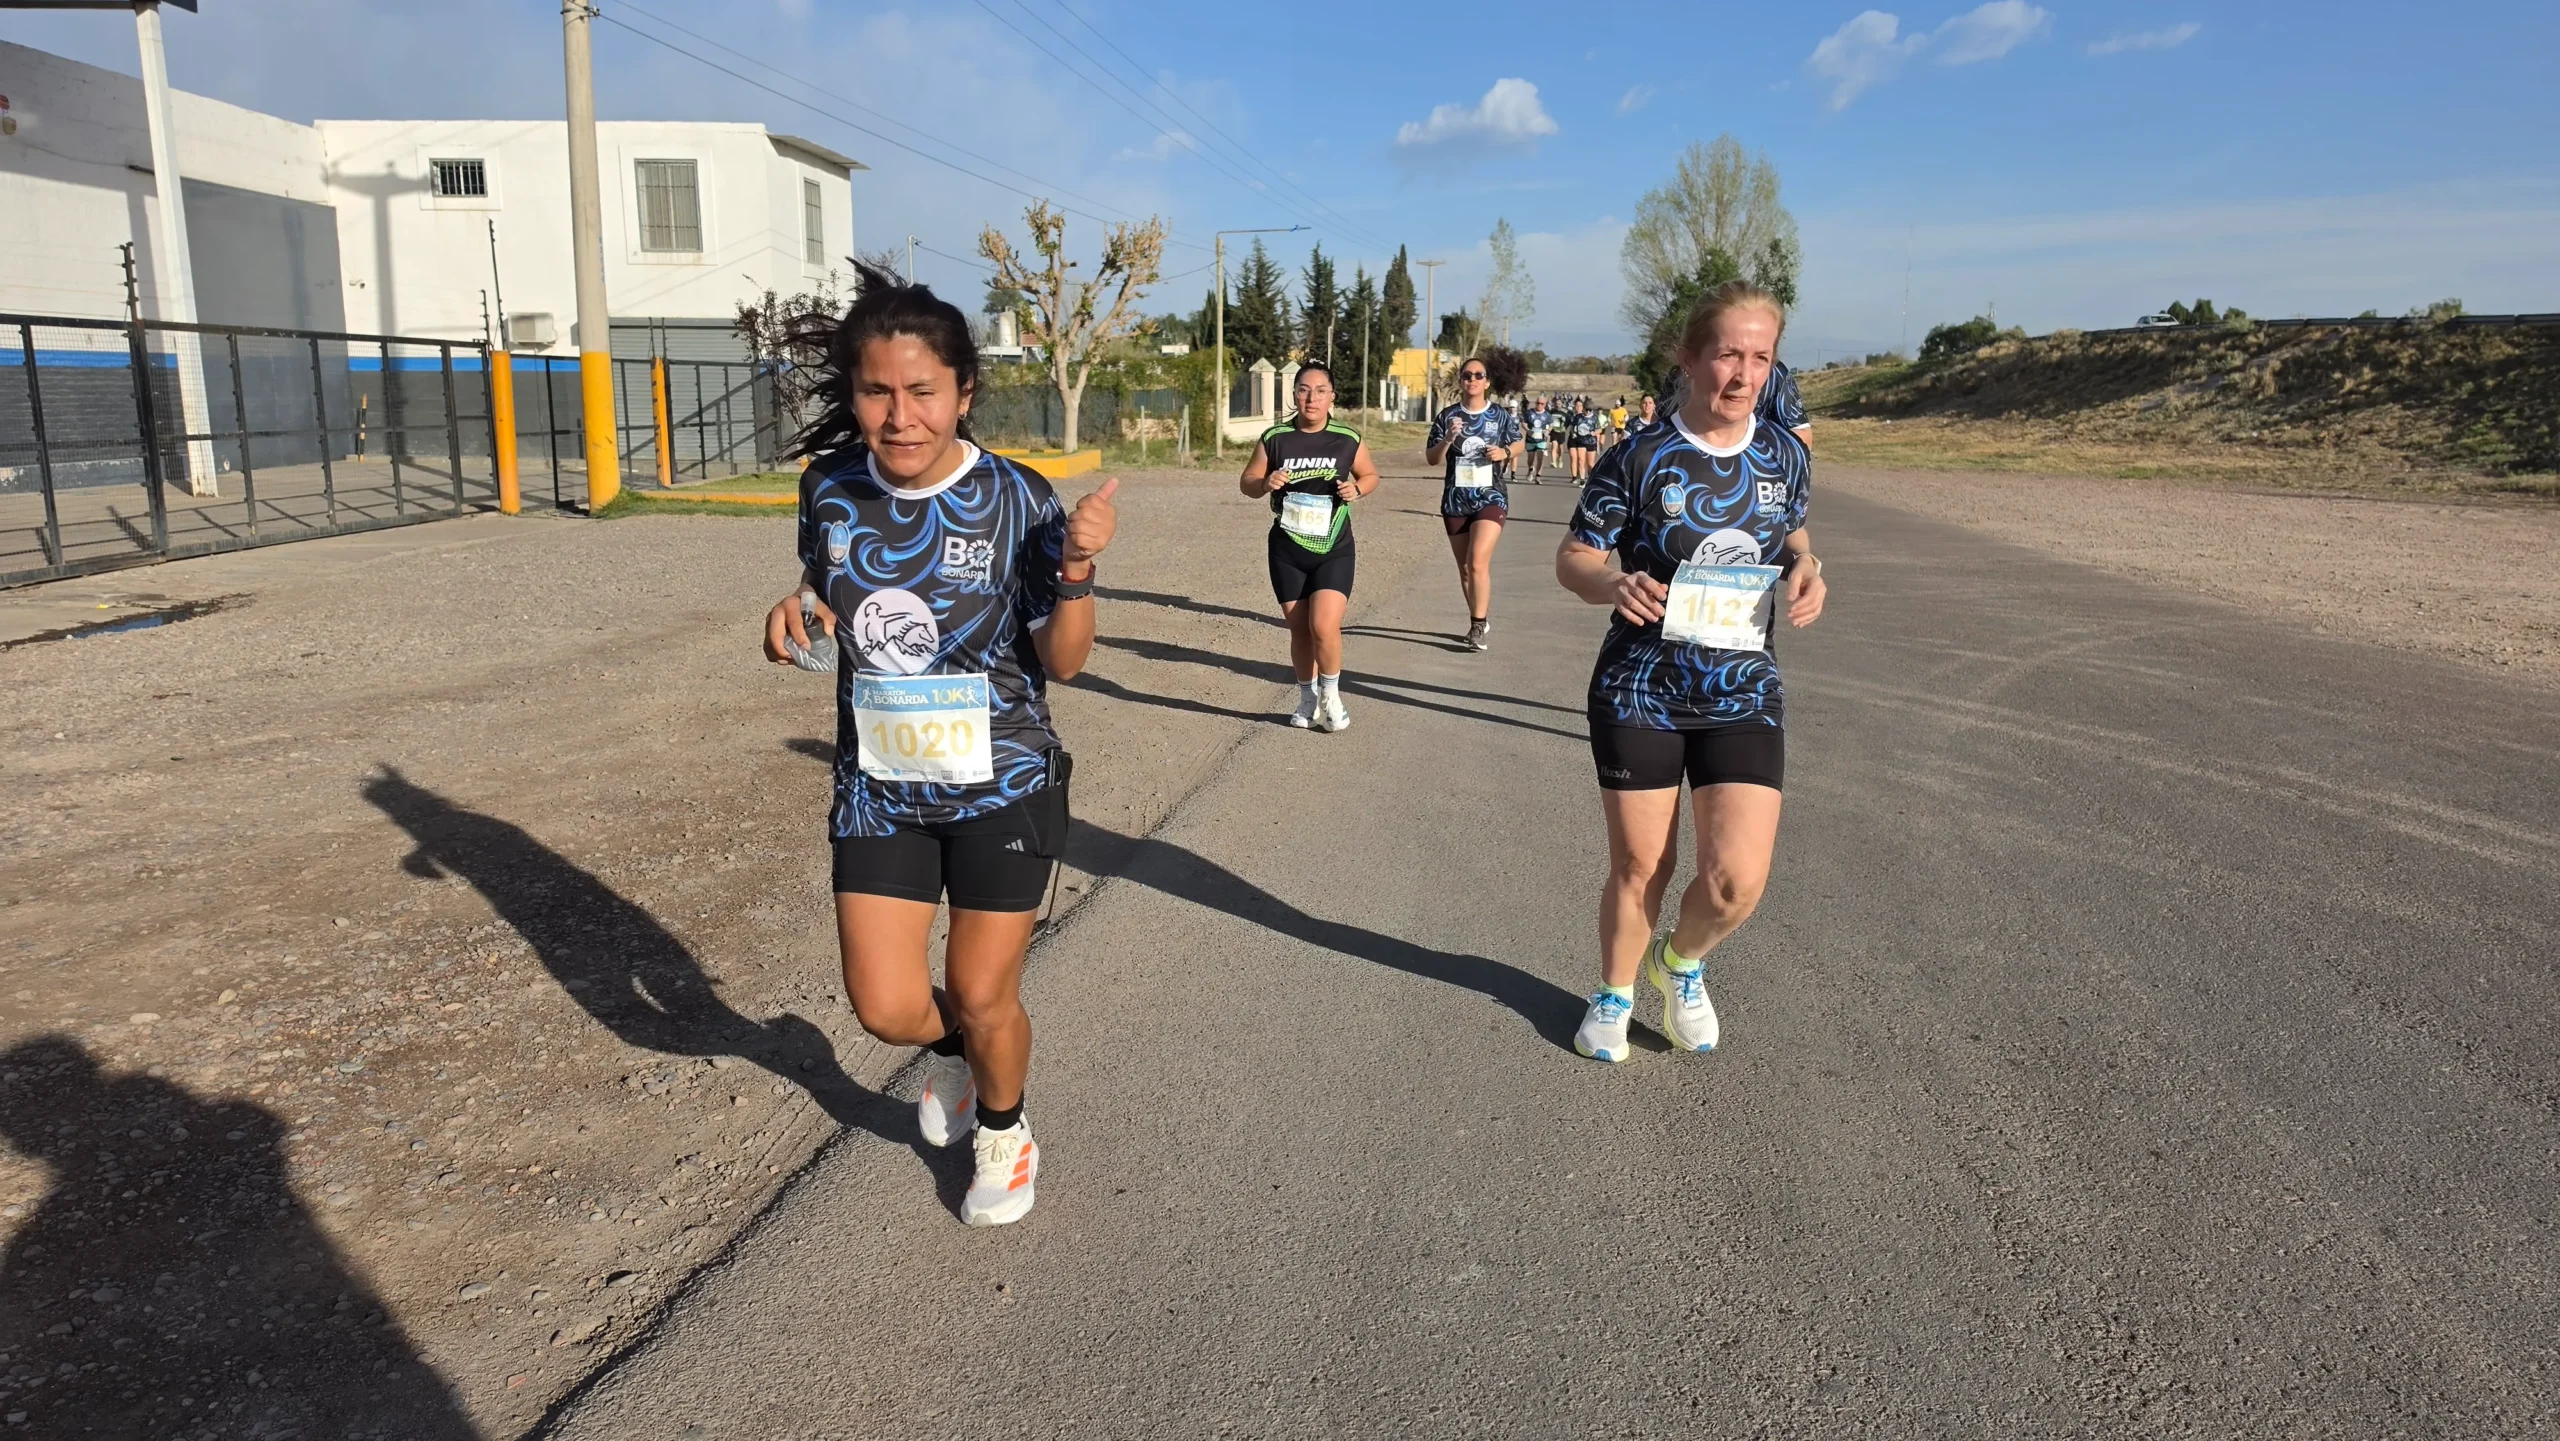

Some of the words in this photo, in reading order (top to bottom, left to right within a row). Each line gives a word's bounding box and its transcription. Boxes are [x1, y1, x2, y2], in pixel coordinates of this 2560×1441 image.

[1282, 457, 1337, 470] JUNIN
[1694, 572, 1736, 584] BONARDA
[874, 694, 929, 705] BONARDA
[932, 687, 966, 704] 10K
[872, 719, 974, 759] 1020
